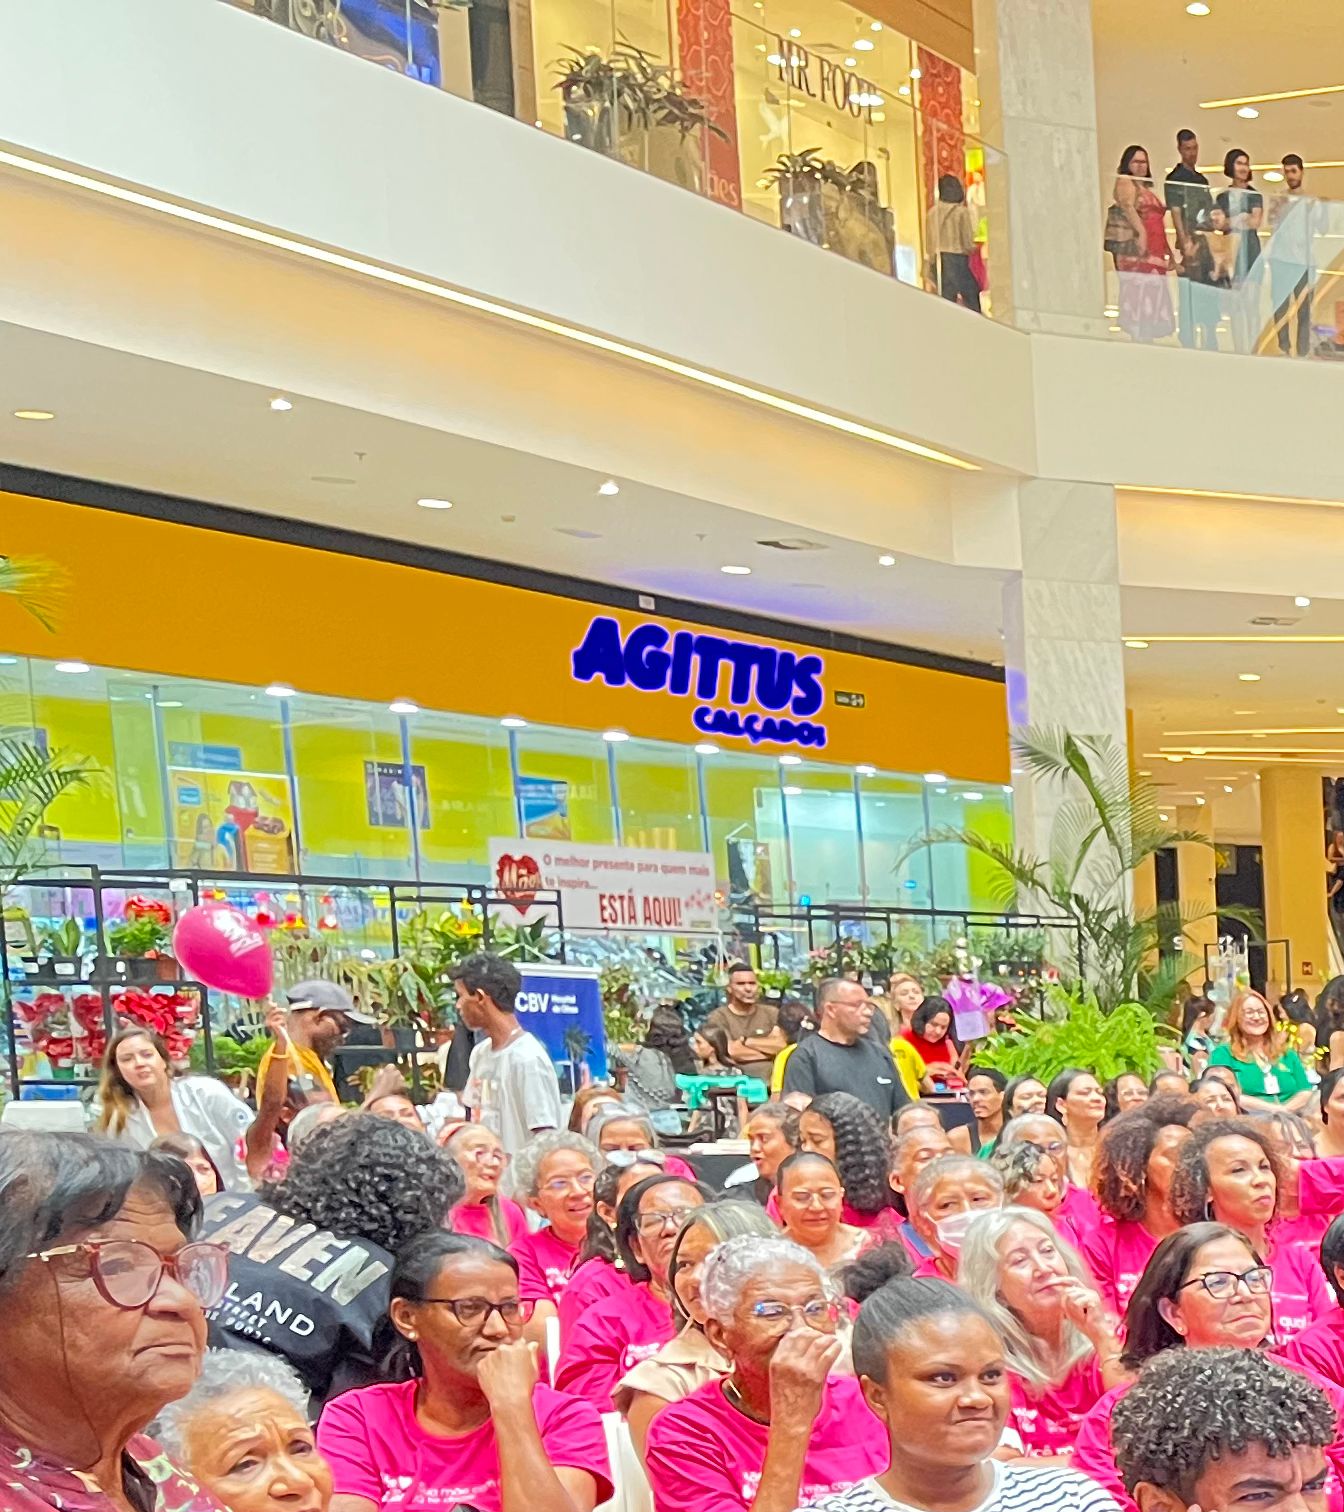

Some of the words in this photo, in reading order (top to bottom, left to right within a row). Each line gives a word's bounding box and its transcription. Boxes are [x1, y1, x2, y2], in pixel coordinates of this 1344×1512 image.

[572, 616, 824, 717] AGITTUS
[693, 705, 827, 748] CALÇADOS
[542, 853, 553, 866] O
[554, 855, 591, 869] melhor
[592, 859, 635, 875] presente
[637, 862, 659, 874] para
[660, 865, 687, 876] quem
[688, 865, 710, 877] mais
[599, 887, 638, 926] ESTÁ
[643, 896, 683, 928] AQUI!
[514, 991, 550, 1013] CBV
[199, 1198, 389, 1306] EAVEN
